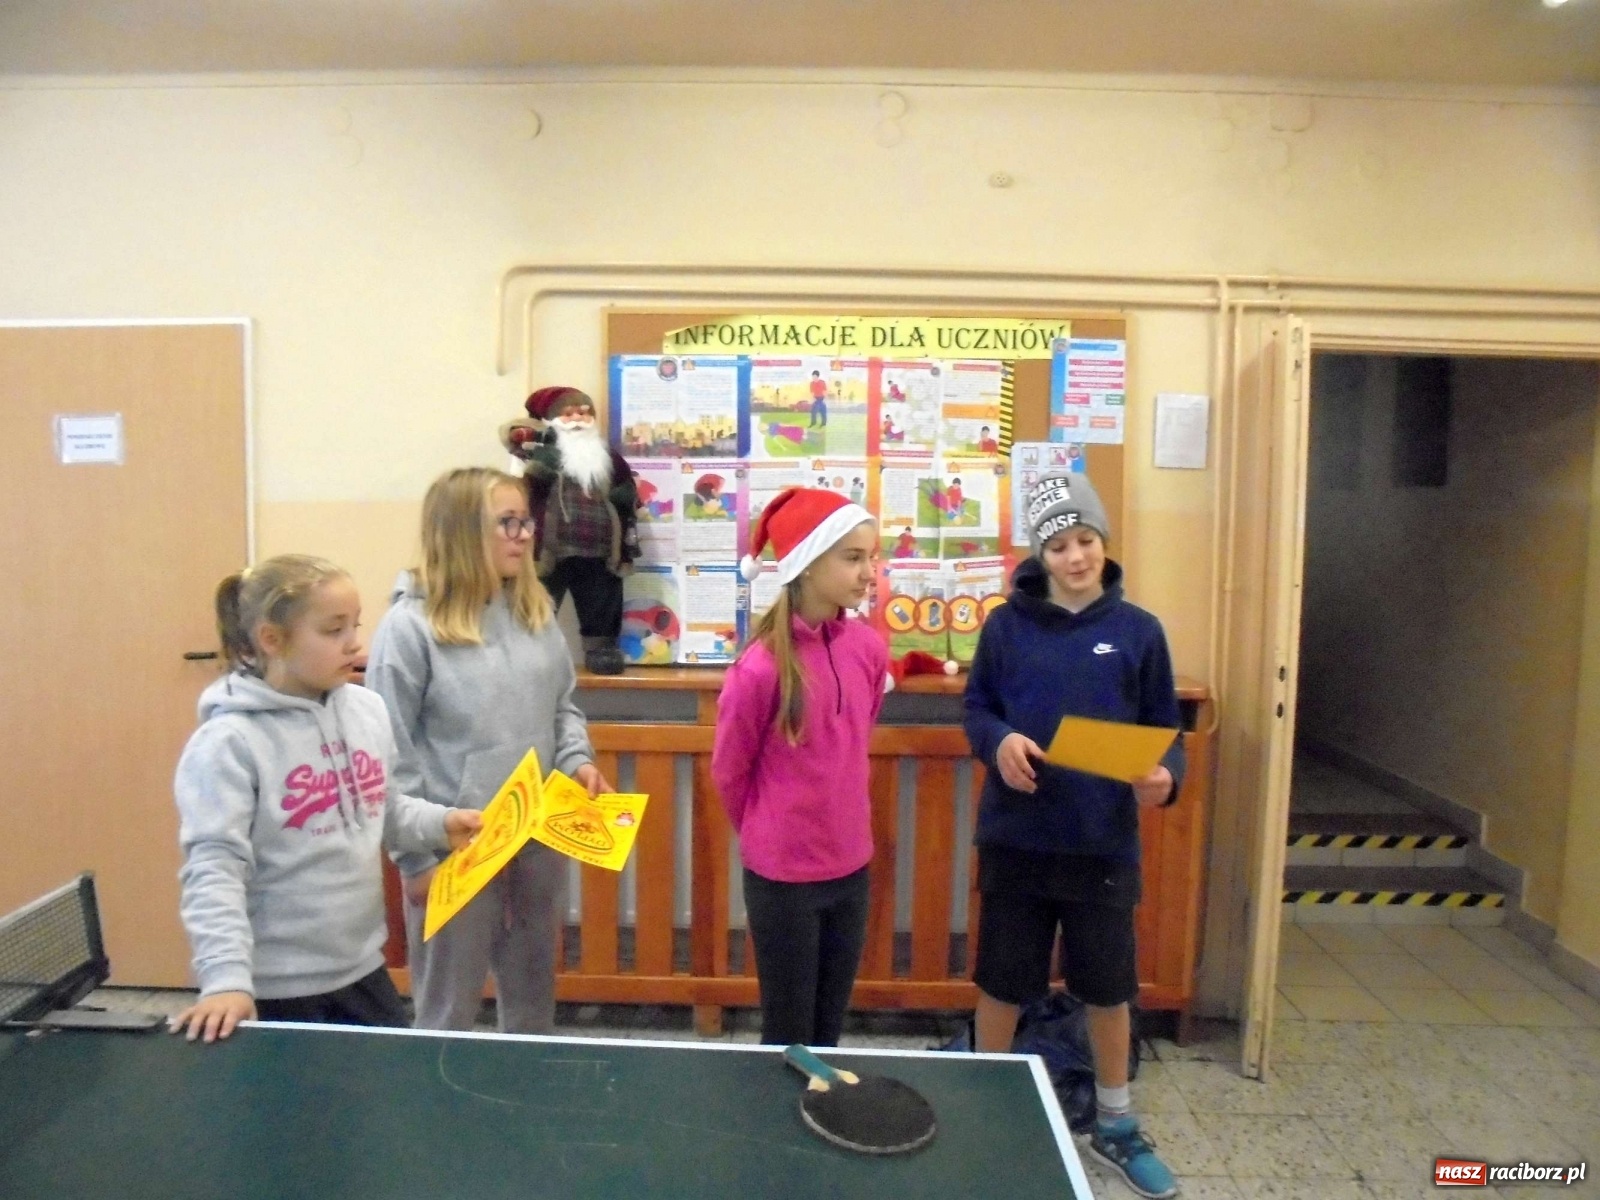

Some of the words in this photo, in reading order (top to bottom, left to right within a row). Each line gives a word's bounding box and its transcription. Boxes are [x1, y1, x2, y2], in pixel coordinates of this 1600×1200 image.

[674, 323, 856, 347] INFORMACJE
[871, 326, 926, 347] DLA
[936, 322, 1065, 350] UCZNIÓW
